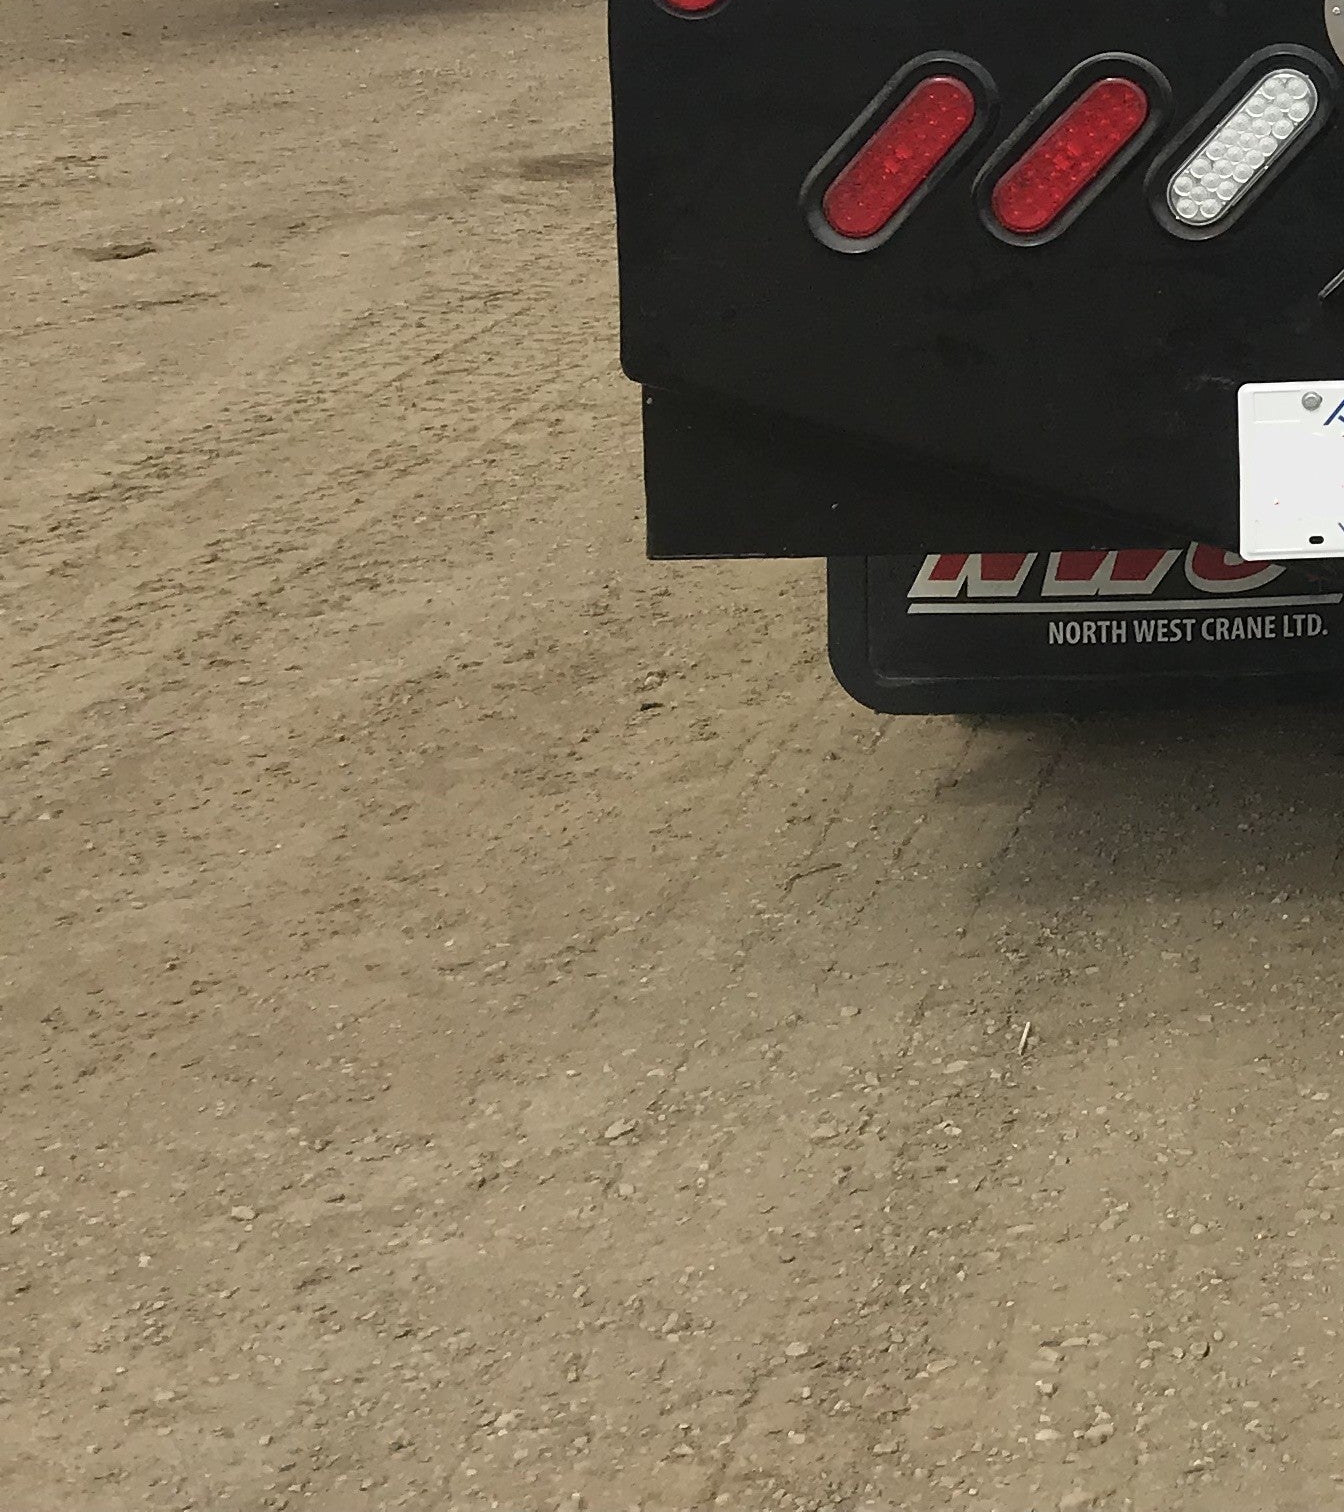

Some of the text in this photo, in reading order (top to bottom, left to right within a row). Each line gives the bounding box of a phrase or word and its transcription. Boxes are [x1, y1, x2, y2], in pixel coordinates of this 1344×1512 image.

[1048, 613, 1329, 645] NORTH WEST CRANE LTD.
